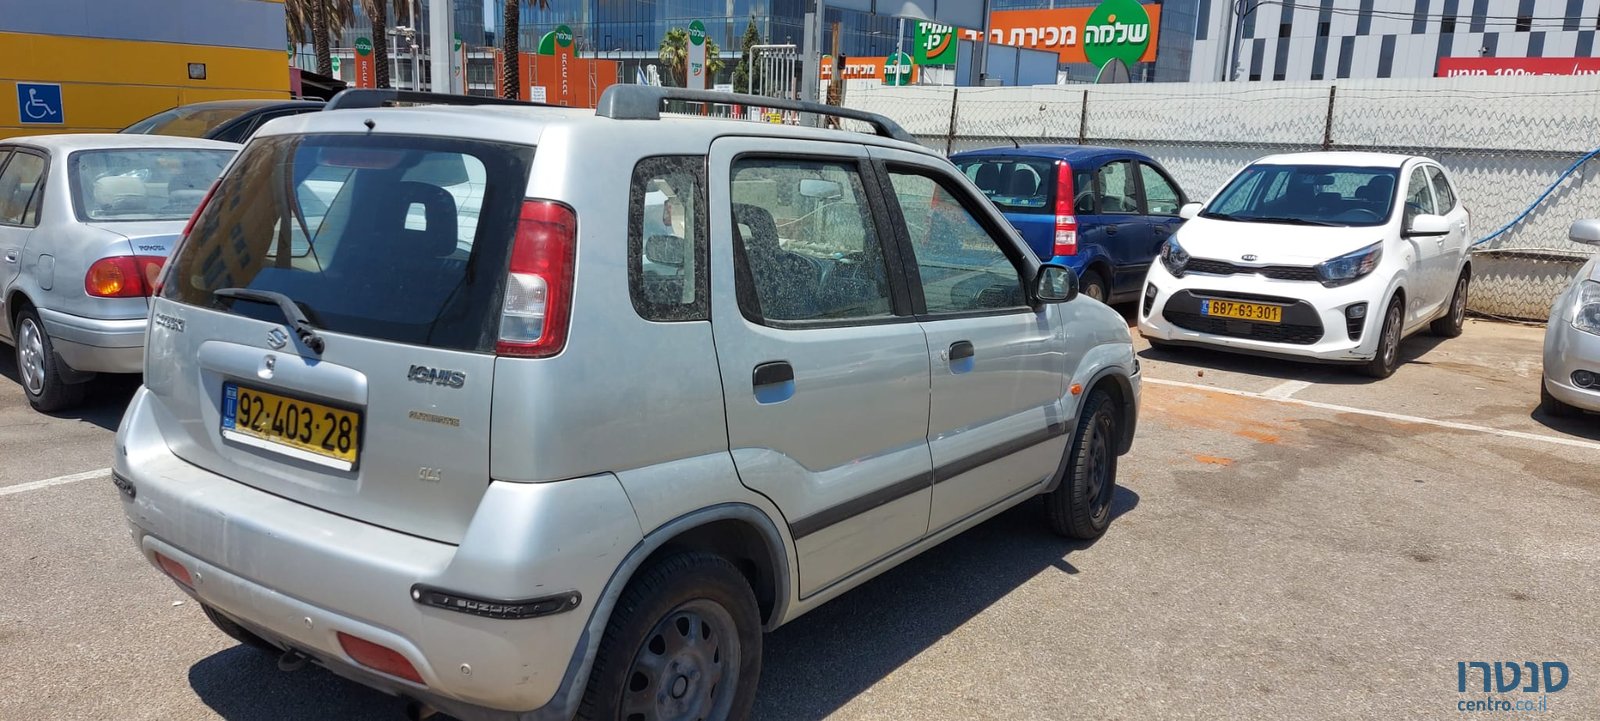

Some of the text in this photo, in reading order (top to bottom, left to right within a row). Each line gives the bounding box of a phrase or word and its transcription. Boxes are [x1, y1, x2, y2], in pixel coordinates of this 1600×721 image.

[919, 22, 952, 34] תמיד
[1008, 25, 1077, 46] מכירת
[1085, 22, 1148, 44] שלמה
[884, 64, 911, 74] שמה
[407, 364, 466, 389] IGNIS
